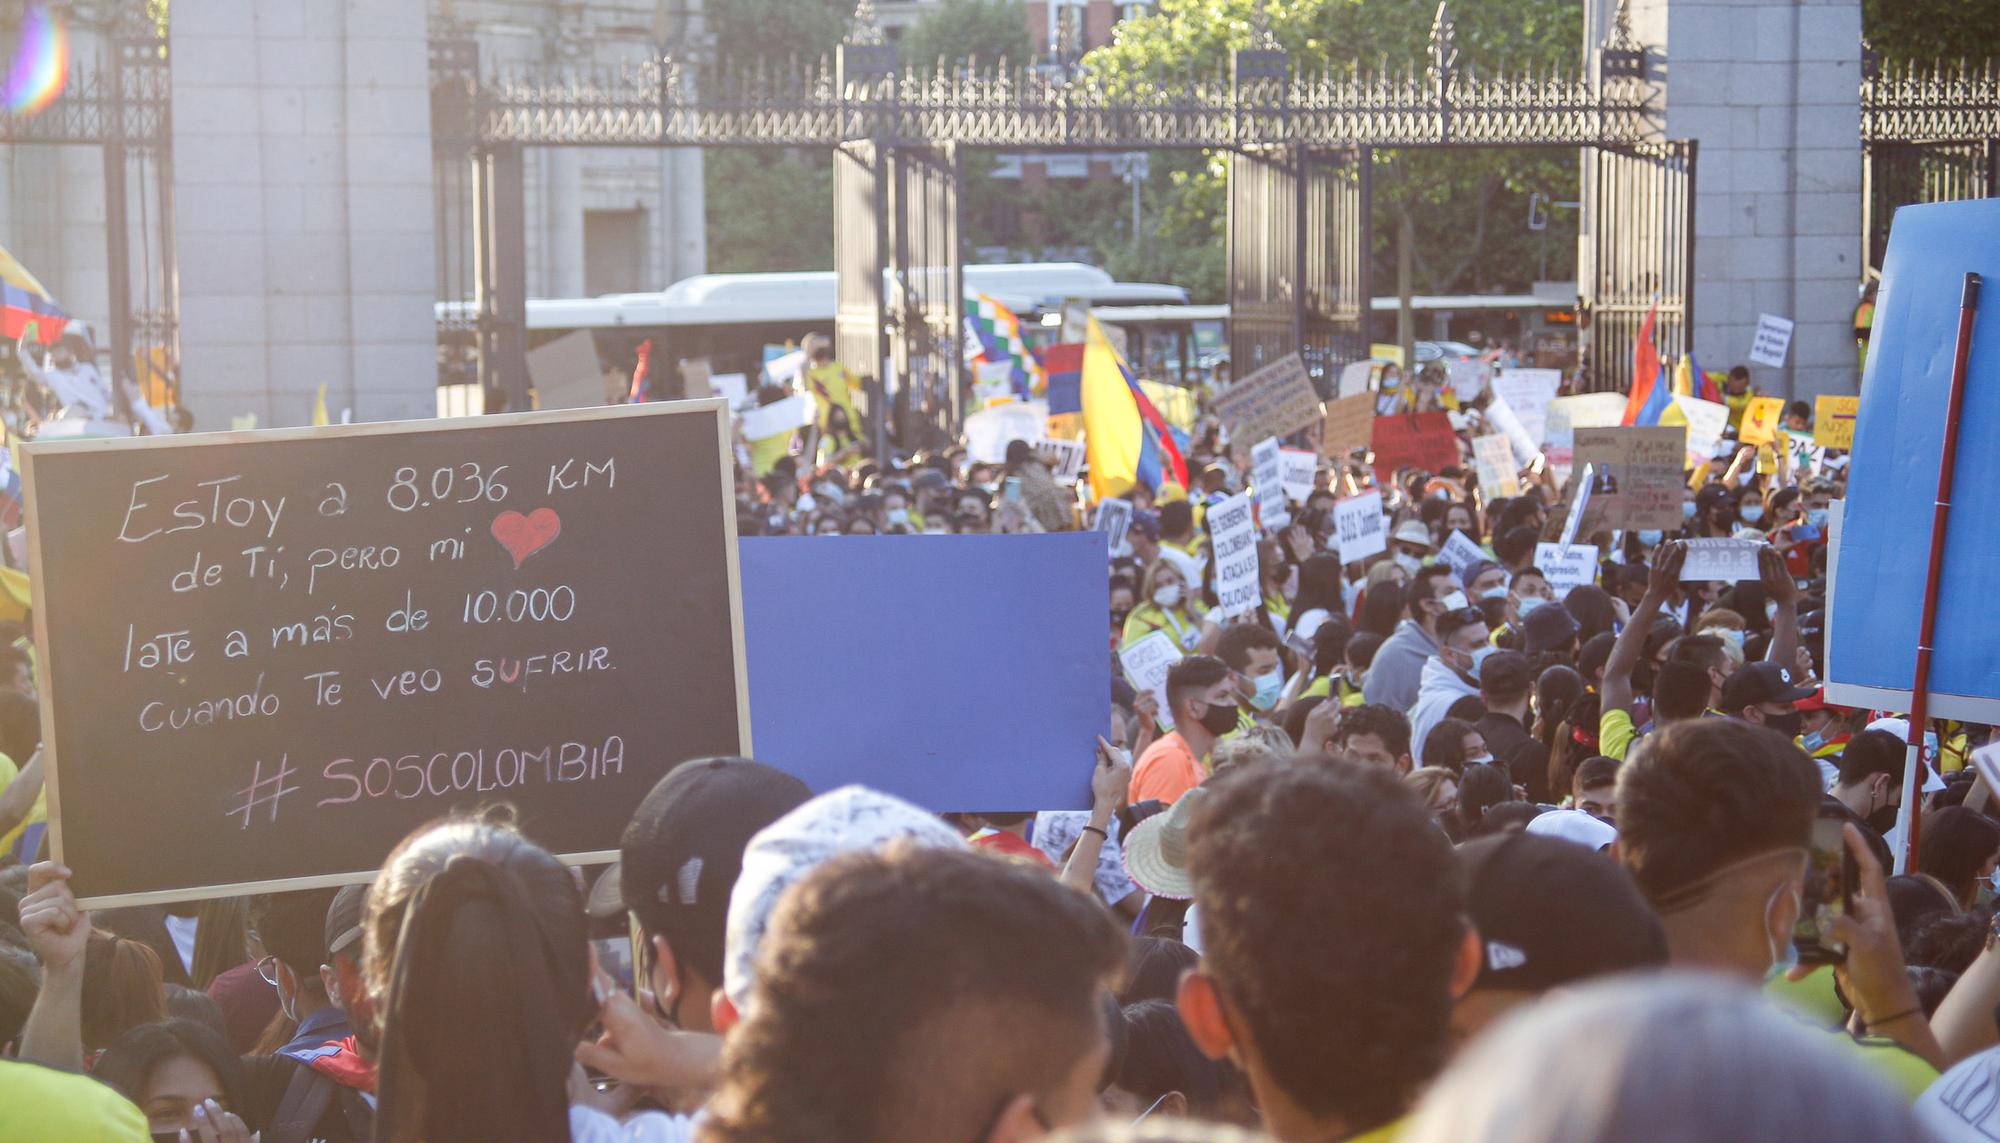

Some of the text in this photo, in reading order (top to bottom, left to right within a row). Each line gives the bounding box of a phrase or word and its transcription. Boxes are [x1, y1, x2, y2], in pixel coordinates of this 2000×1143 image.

[318, 482, 346, 517] a
[387, 462, 510, 512] 8.036
[547, 457, 616, 495] KM
[172, 551, 223, 592] de
[430, 526, 473, 561] mi
[224, 630, 249, 657] a
[272, 604, 355, 649] más
[386, 586, 430, 632] de
[463, 585, 576, 624] 10.000
[303, 671, 342, 706] Te
[371, 669, 442, 700] veo
